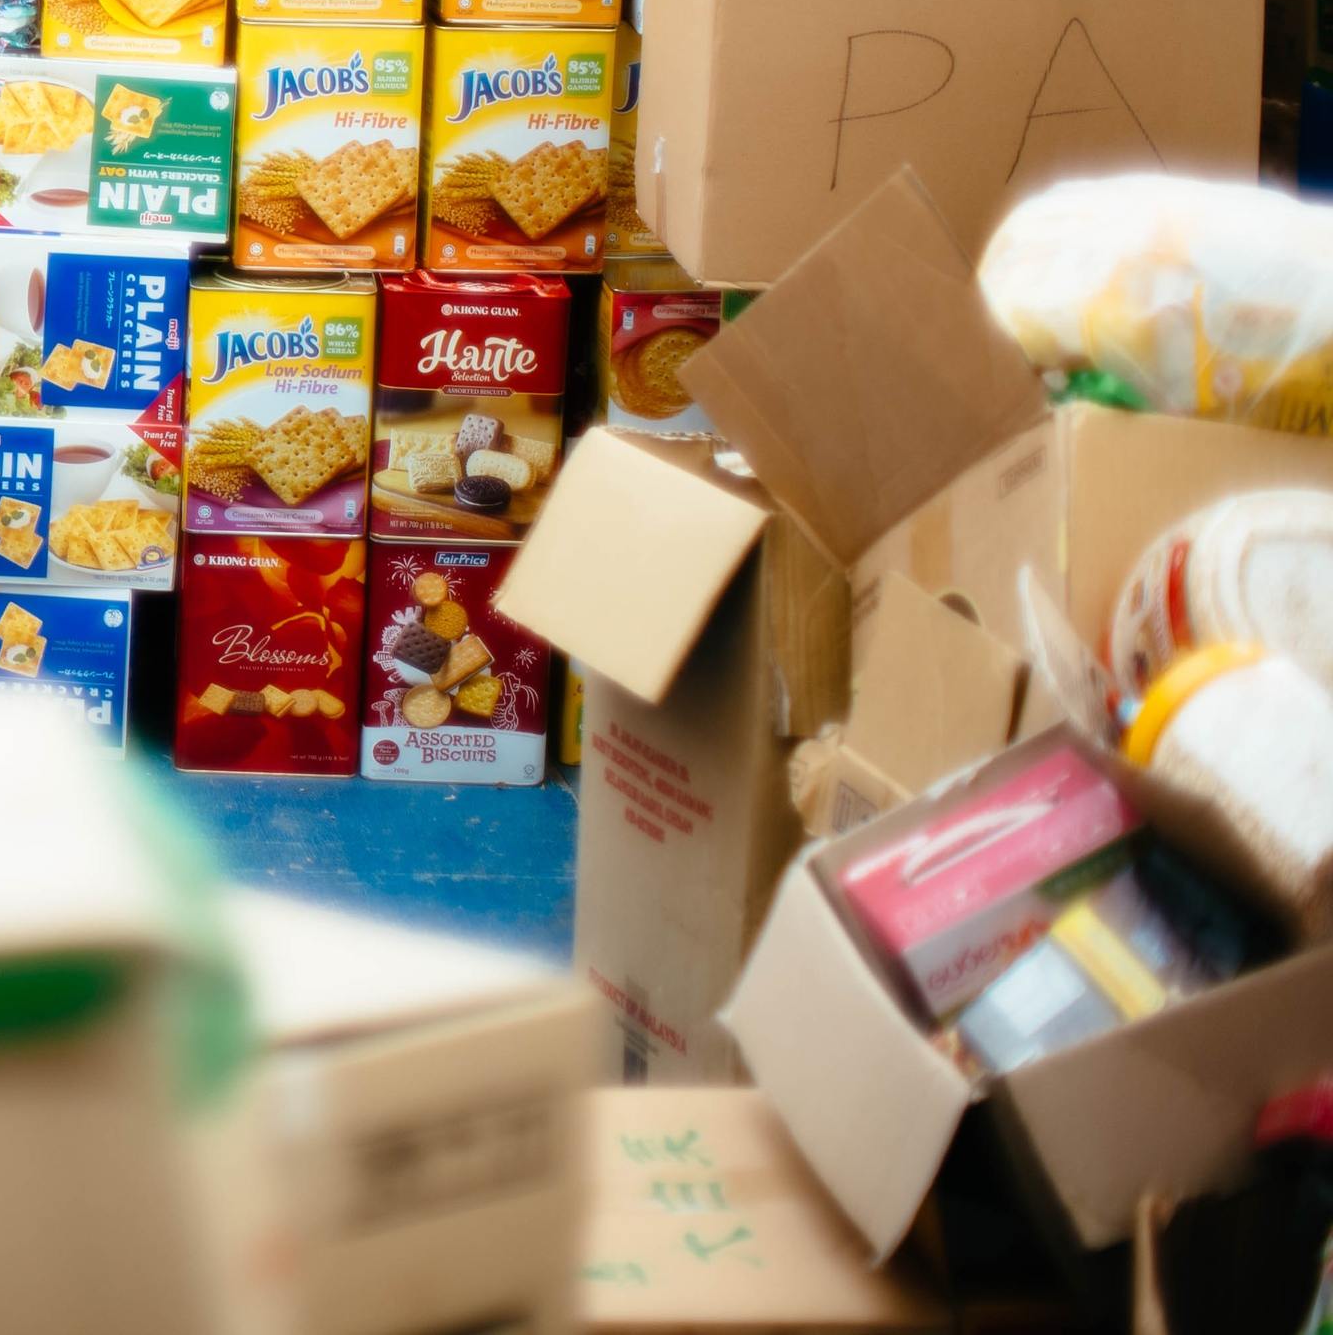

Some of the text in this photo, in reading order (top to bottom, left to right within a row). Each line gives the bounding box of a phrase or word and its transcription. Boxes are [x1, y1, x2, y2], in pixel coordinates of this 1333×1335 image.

[373, 58, 409, 75] 85%
[567, 59, 602, 75] 85%
[252, 50, 370, 120] JACOB'S
[445, 53, 563, 123] JACOB'S
[828, 17, 1170, 192] P A
[333, 111, 408, 130] Hi-Fibre
[527, 114, 601, 131] Hi-Fibre
[98, 182, 217, 215] PLAIN
[139, 213, 173, 225] meiji
[120, 274, 135, 390] CRACKERS
[137, 274, 166, 392] PLAIN
[167, 318, 178, 351] meiji
[324, 323, 360, 339] 86%
[201, 315, 320, 384] JACOB'S
[417, 329, 538, 381] Haute
[265, 364, 363, 379] Low Sodium
[451, 370, 491, 383] Selection
[274, 379, 339, 395] Hi-Fibre
[447, 387, 508, 397] ASSORTED BISCUITS
[143, 431, 177, 440] Trans Fat
[159, 439, 177, 447] Free
[208, 556, 279, 568] KHONG GUAN
[436, 553, 488, 565] FairPrice
[212, 624, 330, 666] Blossoms
[404, 731, 496, 748] ASSORTED
[421, 746, 497, 764] BISCUITS
